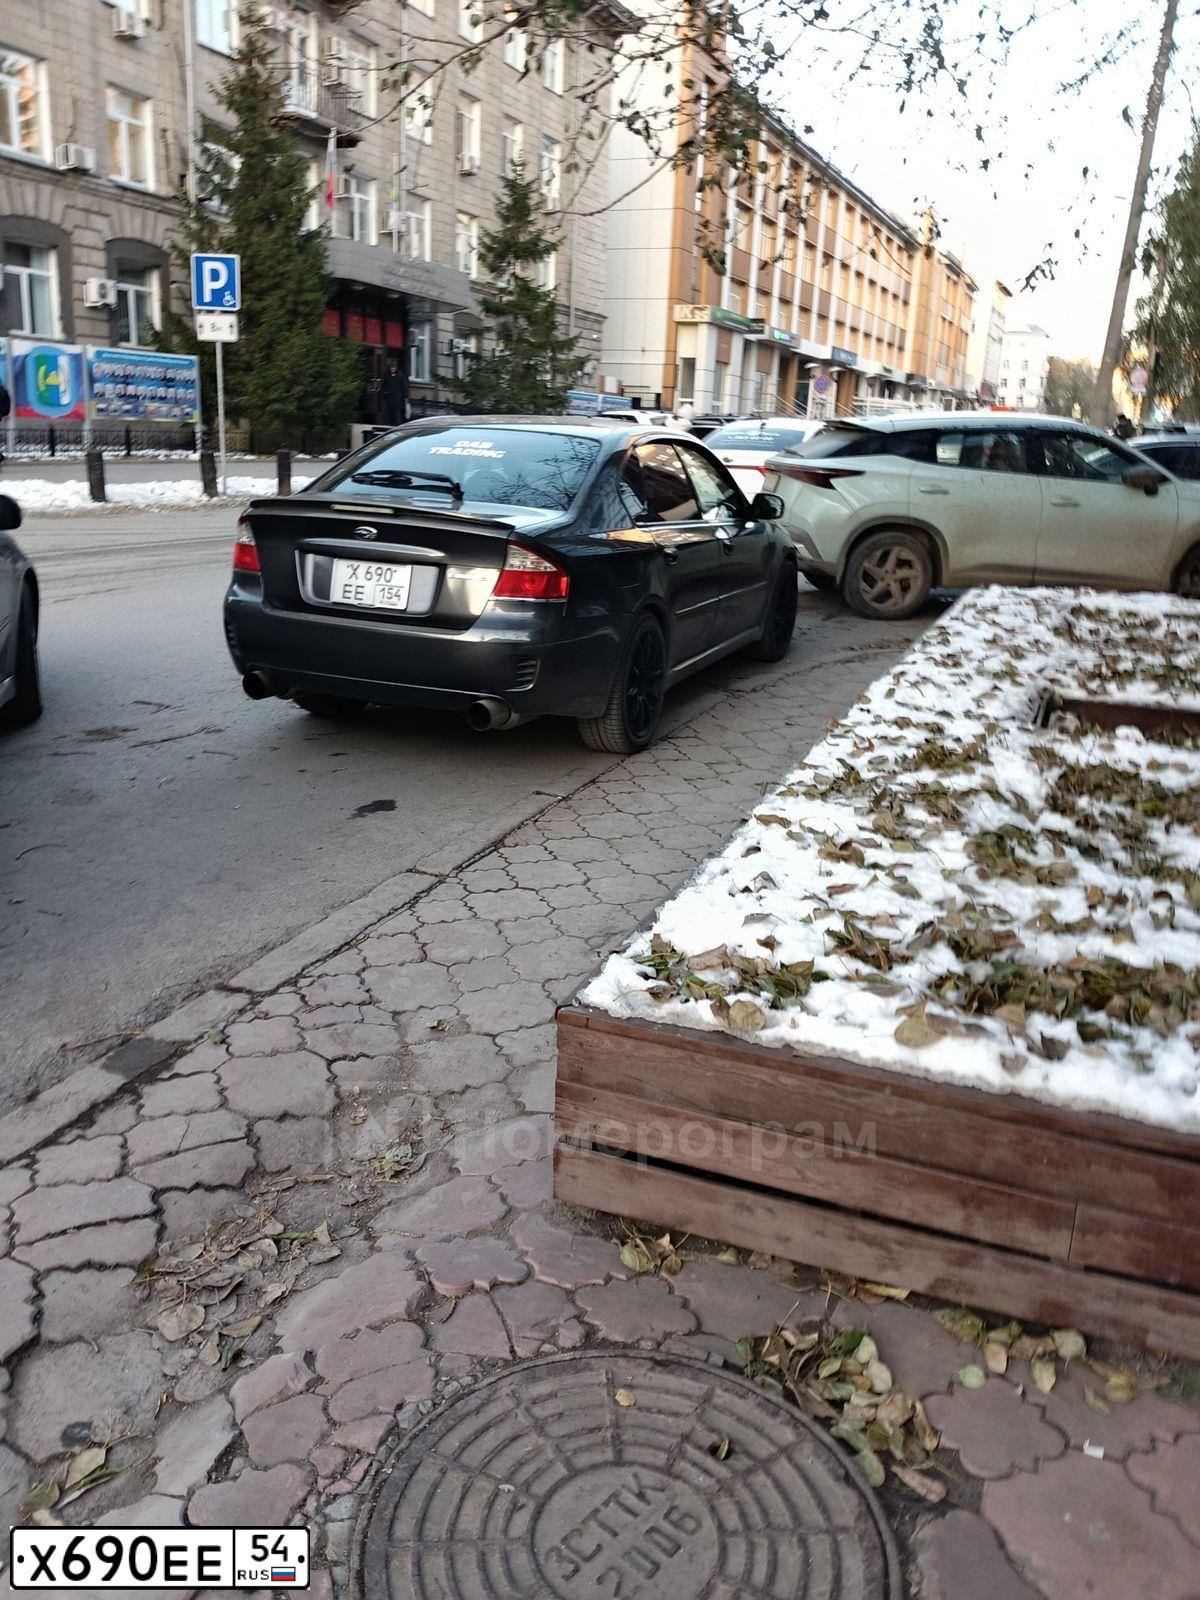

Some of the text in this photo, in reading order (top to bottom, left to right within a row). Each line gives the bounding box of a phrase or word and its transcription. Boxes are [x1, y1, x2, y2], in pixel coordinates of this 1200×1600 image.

[202, 260, 229, 303] P
[364, 565, 393, 583] 690
[342, 583, 365, 601] ЕЕ
[378, 586, 402, 601] 154
